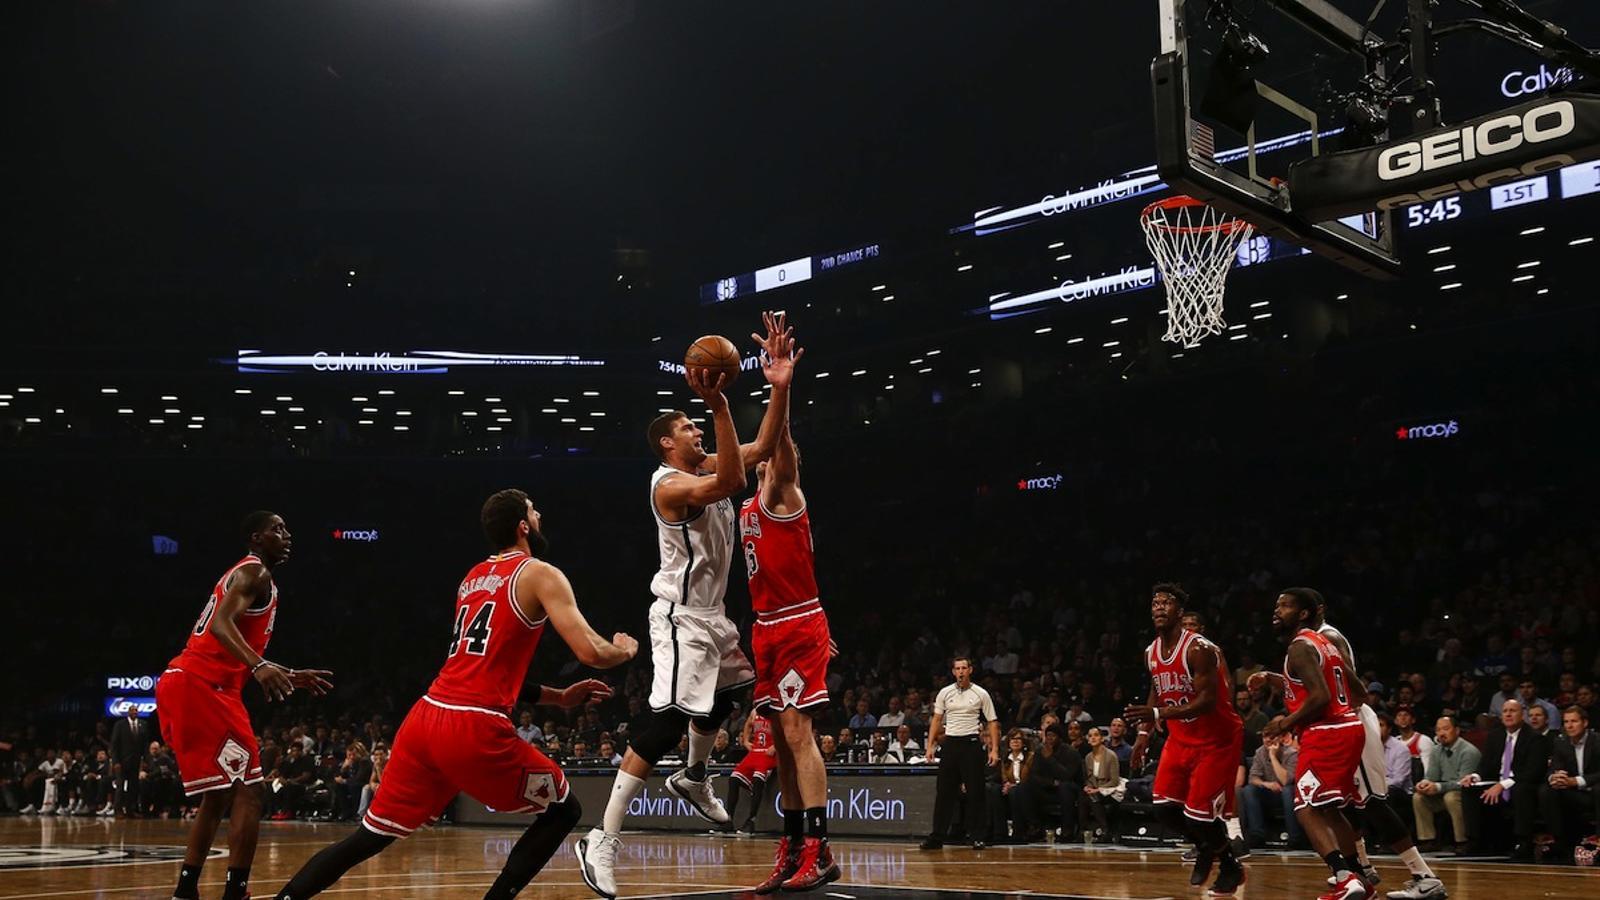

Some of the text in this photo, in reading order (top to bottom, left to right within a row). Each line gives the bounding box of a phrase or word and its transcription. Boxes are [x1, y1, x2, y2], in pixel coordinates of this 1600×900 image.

[1378, 101, 1575, 180] GEICO
[1040, 174, 1142, 216] Calvin Klein
[1503, 183, 1536, 203] 1ST
[1408, 196, 1462, 227] 5:45
[836, 248, 864, 266] CHANCE
[864, 244, 880, 258] PTS
[778, 269, 786, 282] 0
[1059, 276, 1117, 302] Calvin
[312, 351, 420, 371] Calvin Klein
[1409, 419, 1459, 439] macy's
[342, 529, 379, 542] macy's
[448, 600, 496, 658] 44
[1152, 671, 1194, 697] BULLS
[1332, 665, 1349, 706] 0
[625, 788, 673, 817] alvin
[848, 788, 905, 820] Klein
